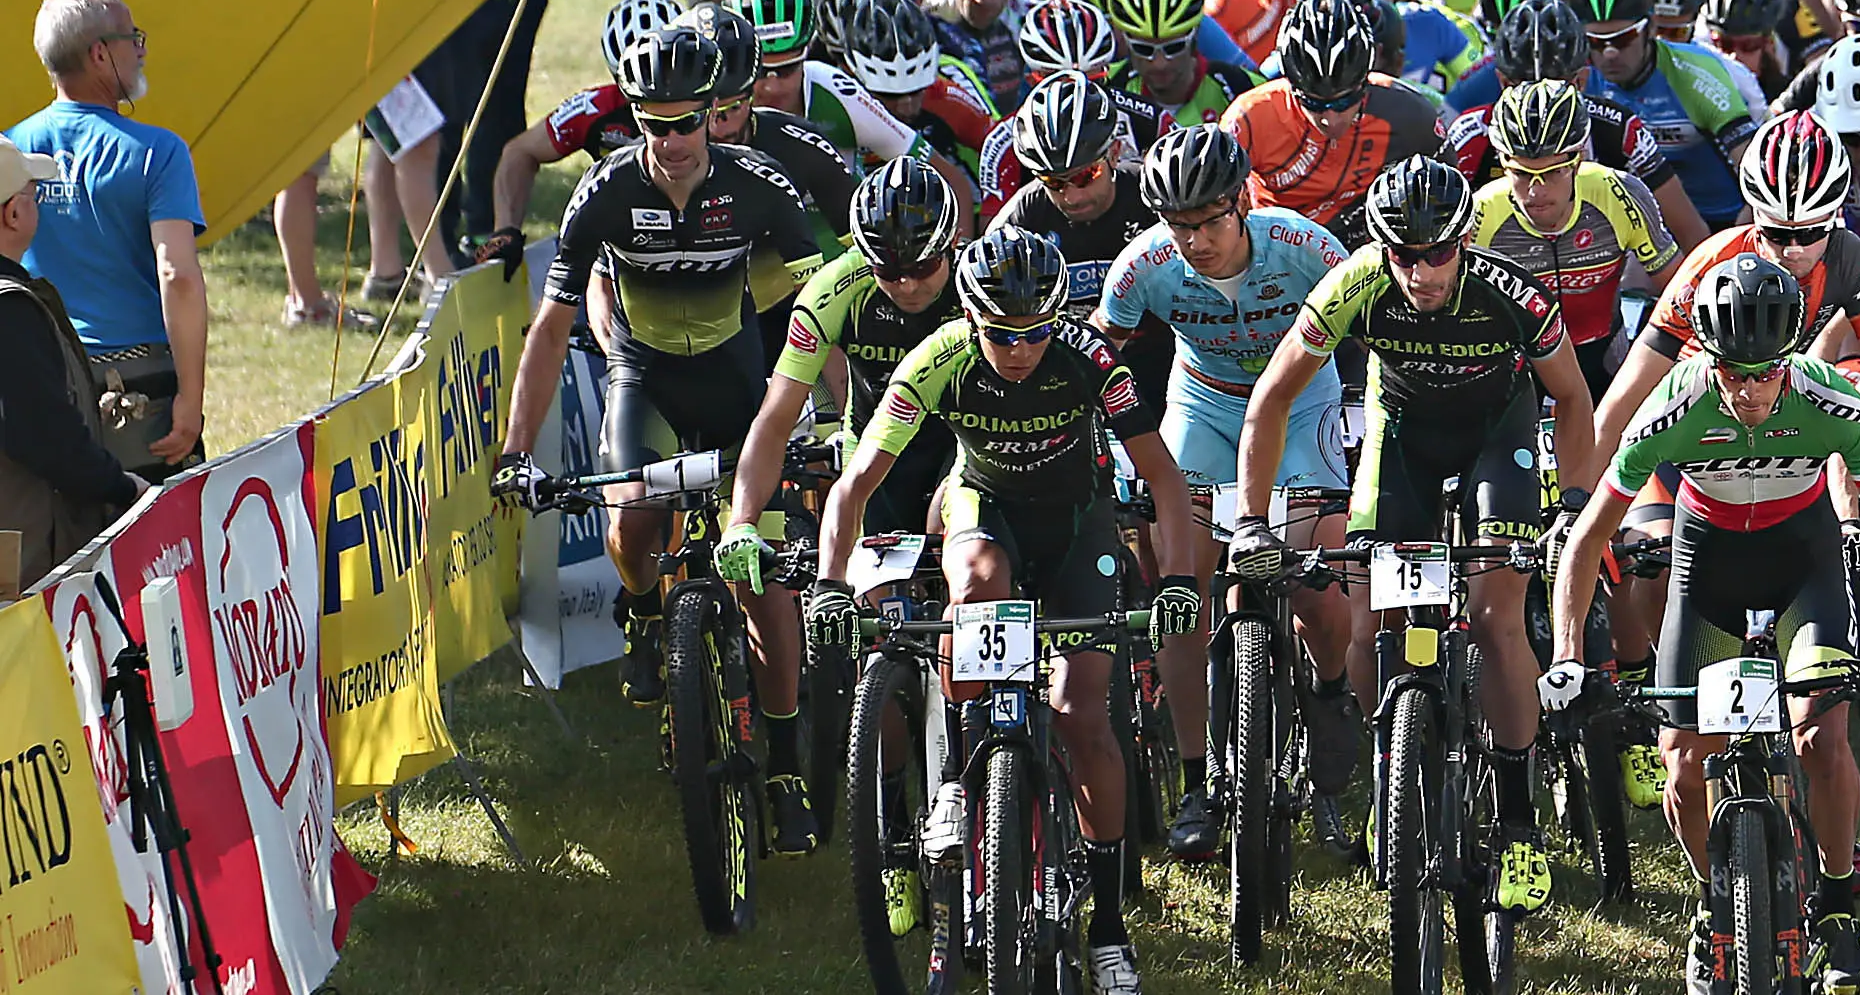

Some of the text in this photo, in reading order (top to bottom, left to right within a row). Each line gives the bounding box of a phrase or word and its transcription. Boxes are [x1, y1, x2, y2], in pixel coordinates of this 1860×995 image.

[1270, 223, 1304, 247] Club
[1112, 270, 1135, 300] Club
[1469, 254, 1539, 308] FRM
[1169, 301, 1300, 325] bike pro
[948, 403, 1086, 435] POLIMEDICA
[1624, 393, 1692, 447] SCOTT
[673, 459, 686, 492] 1
[1676, 456, 1829, 475] SCOTT
[1396, 563, 1423, 592] 15
[978, 623, 1007, 661] 35
[1730, 679, 1746, 714] 2
